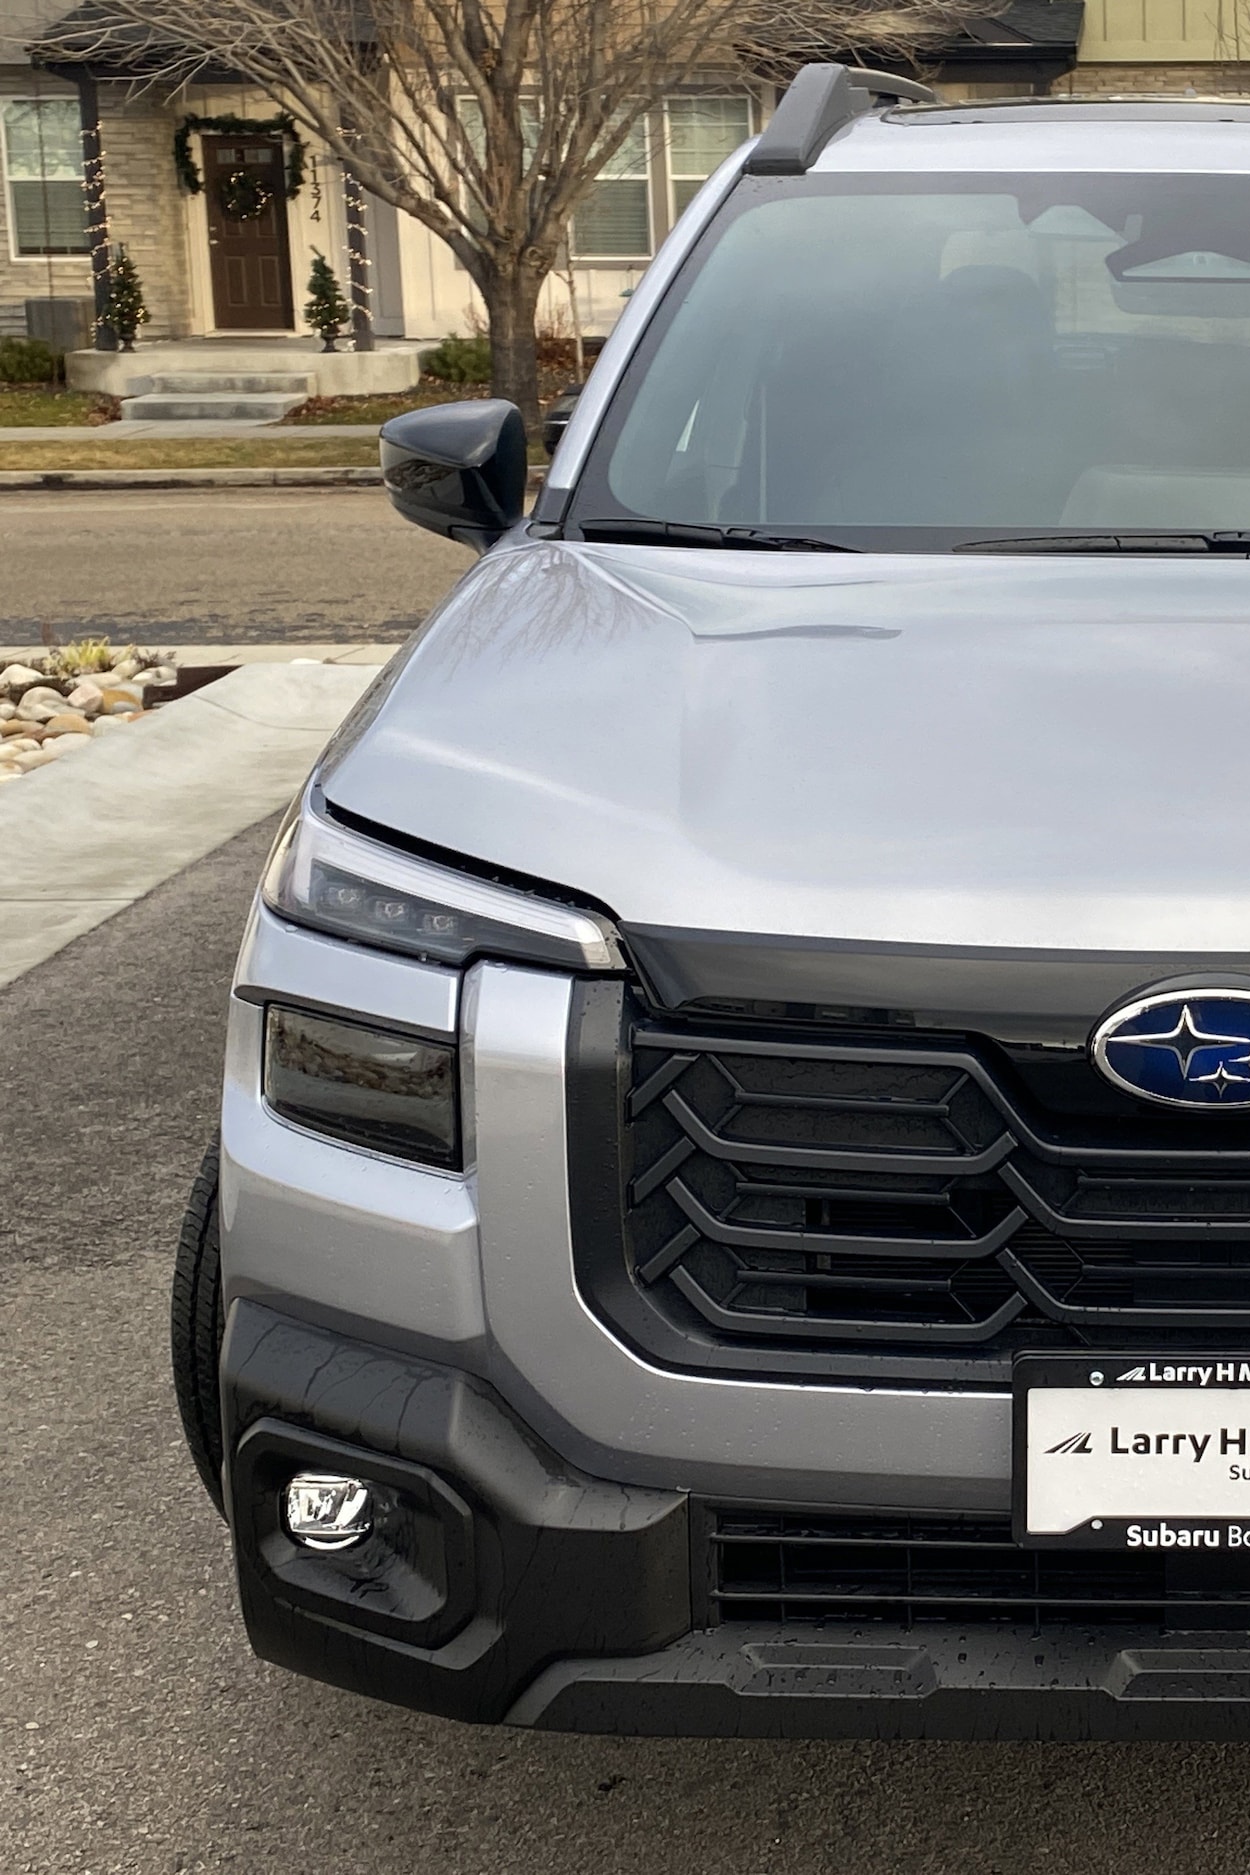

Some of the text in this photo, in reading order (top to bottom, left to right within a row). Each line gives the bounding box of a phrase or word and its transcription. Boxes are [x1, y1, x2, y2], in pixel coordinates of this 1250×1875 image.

[309, 155, 321, 223] 11374
[1149, 1362, 1212, 1386] Larry
[1217, 1363, 1234, 1381] H
[1111, 1426, 1212, 1462] Larry
[1219, 1428, 1246, 1455] H
[1127, 1524, 1219, 1547] Subaru
